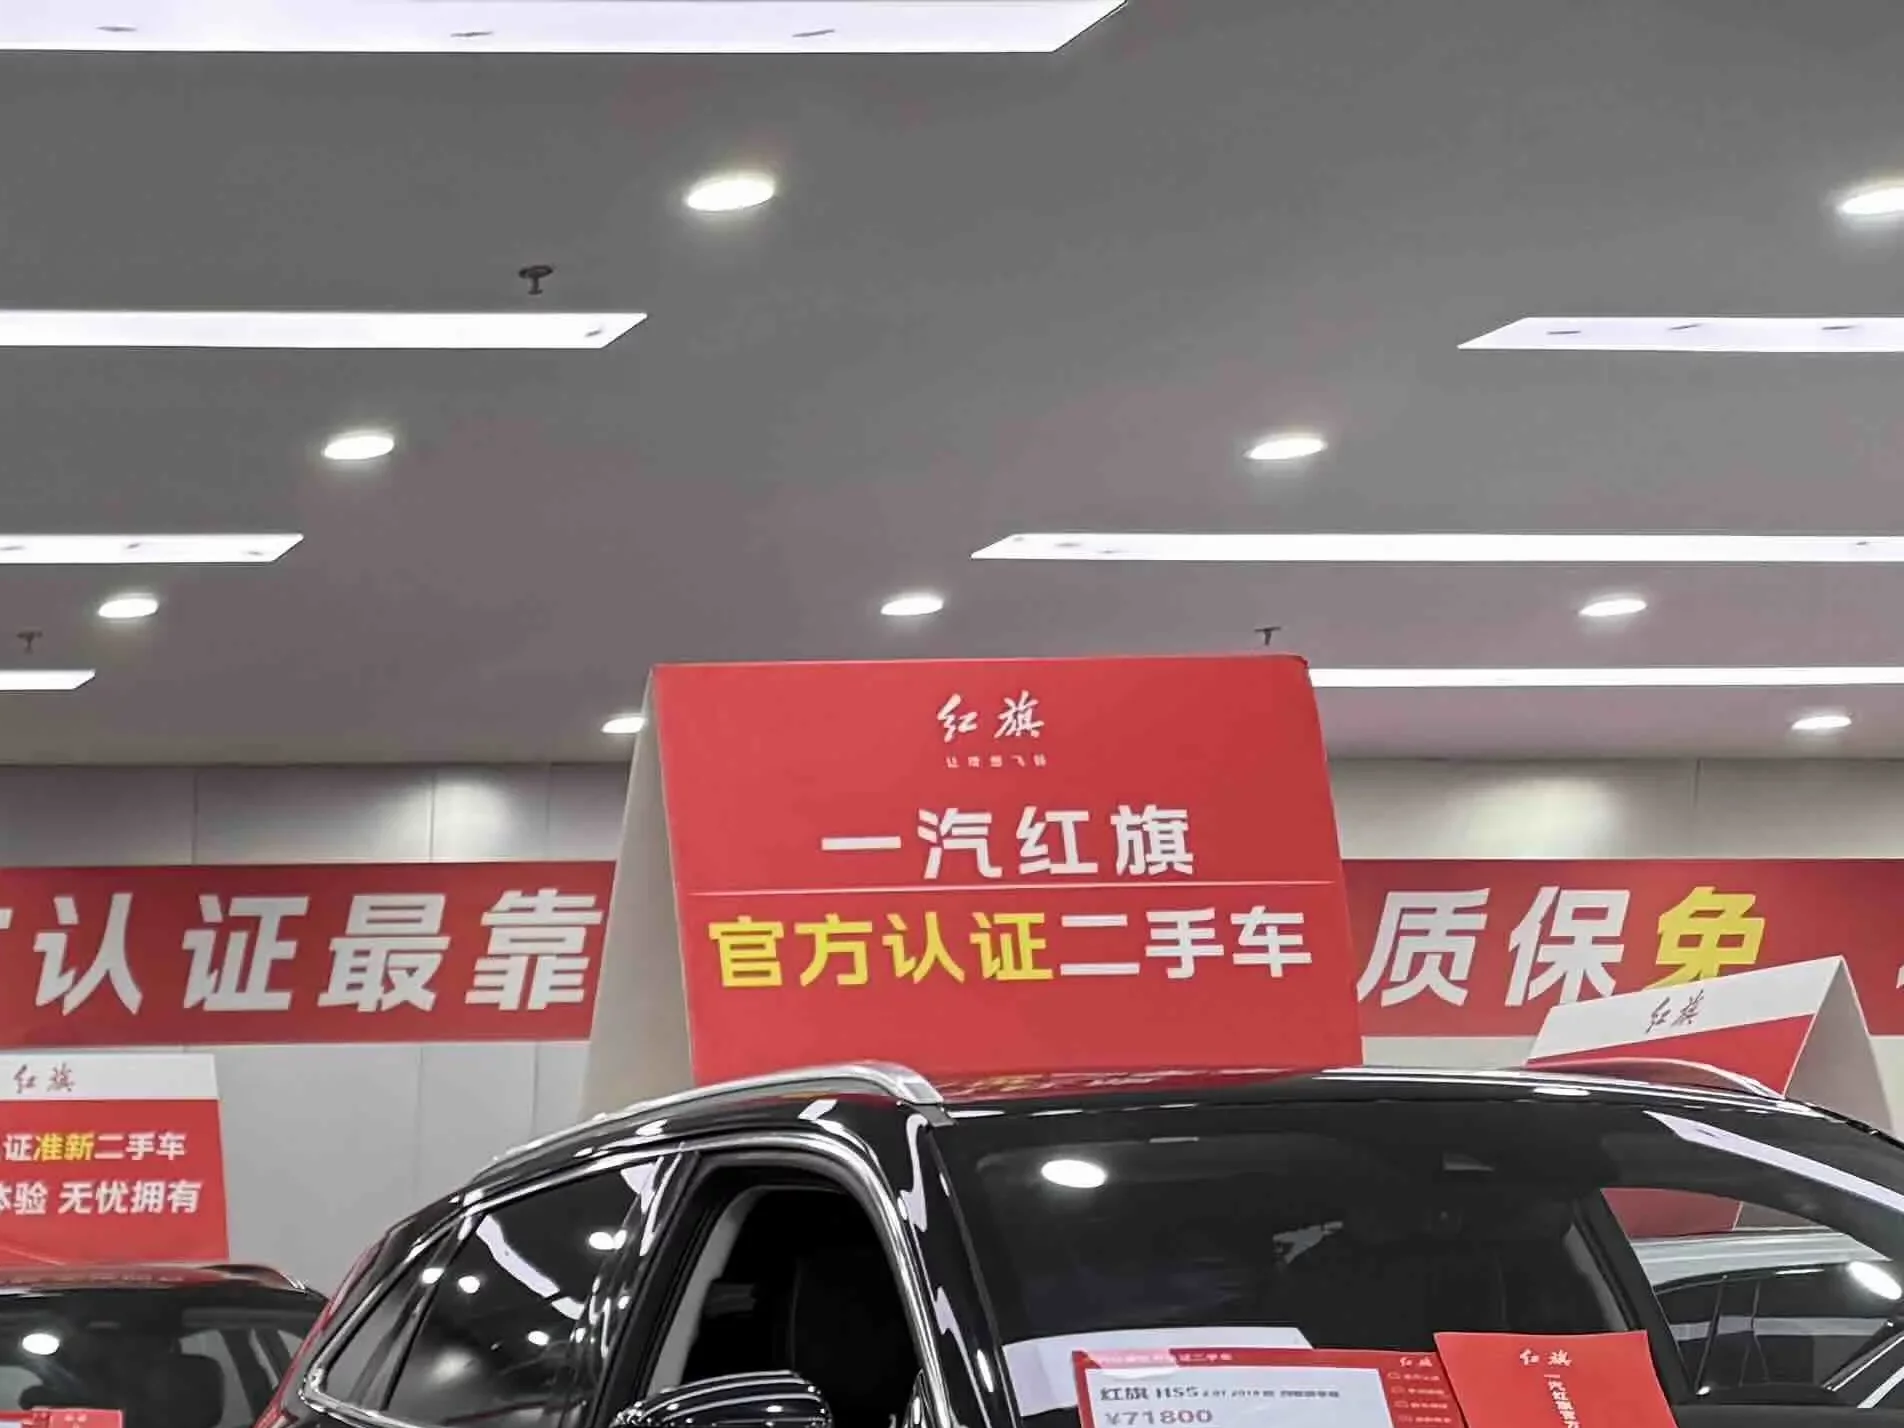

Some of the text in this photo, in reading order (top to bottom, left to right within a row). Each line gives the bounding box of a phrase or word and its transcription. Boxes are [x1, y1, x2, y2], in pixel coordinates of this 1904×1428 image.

[937, 690, 1044, 742] 红旗
[822, 806, 1195, 880] 一汽红旗
[708, 904, 1313, 990] 官方认证二手车
[1358, 886, 1904, 1006] 质保免
[1646, 989, 1704, 1034] 红旗
[13, 1063, 76, 1094] 红旗
[58, 1180, 202, 1214] 无忧拥有
